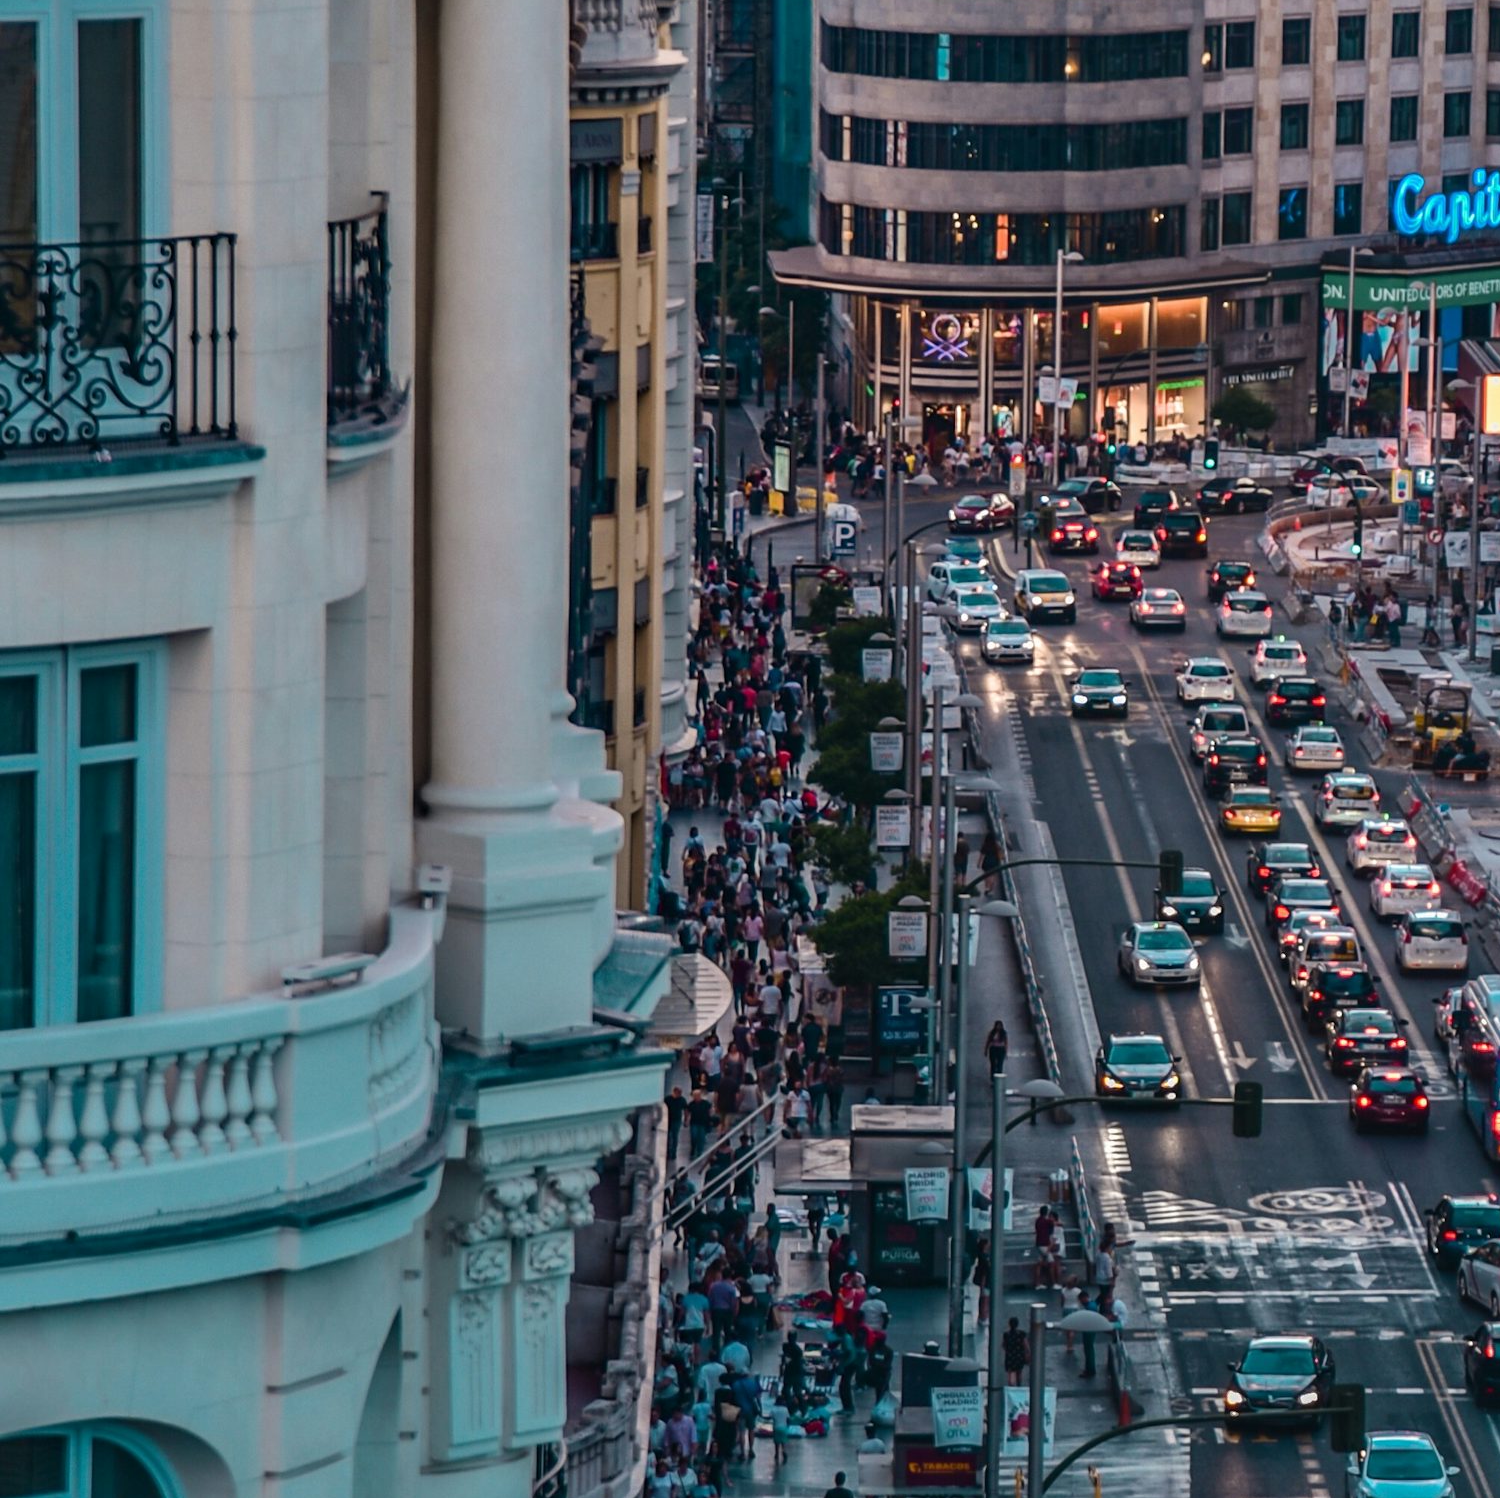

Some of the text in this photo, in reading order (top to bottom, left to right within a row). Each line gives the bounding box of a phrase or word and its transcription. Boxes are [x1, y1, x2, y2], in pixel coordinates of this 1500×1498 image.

[1370, 286, 1419, 302] UNITED
[1455, 282, 1468, 297] OF
[836, 523, 854, 548] P
[908, 1171, 946, 1179] MADRID
[936, 1391, 979, 1399] ORGULLO
[922, 1462, 971, 1471] TABACOS
